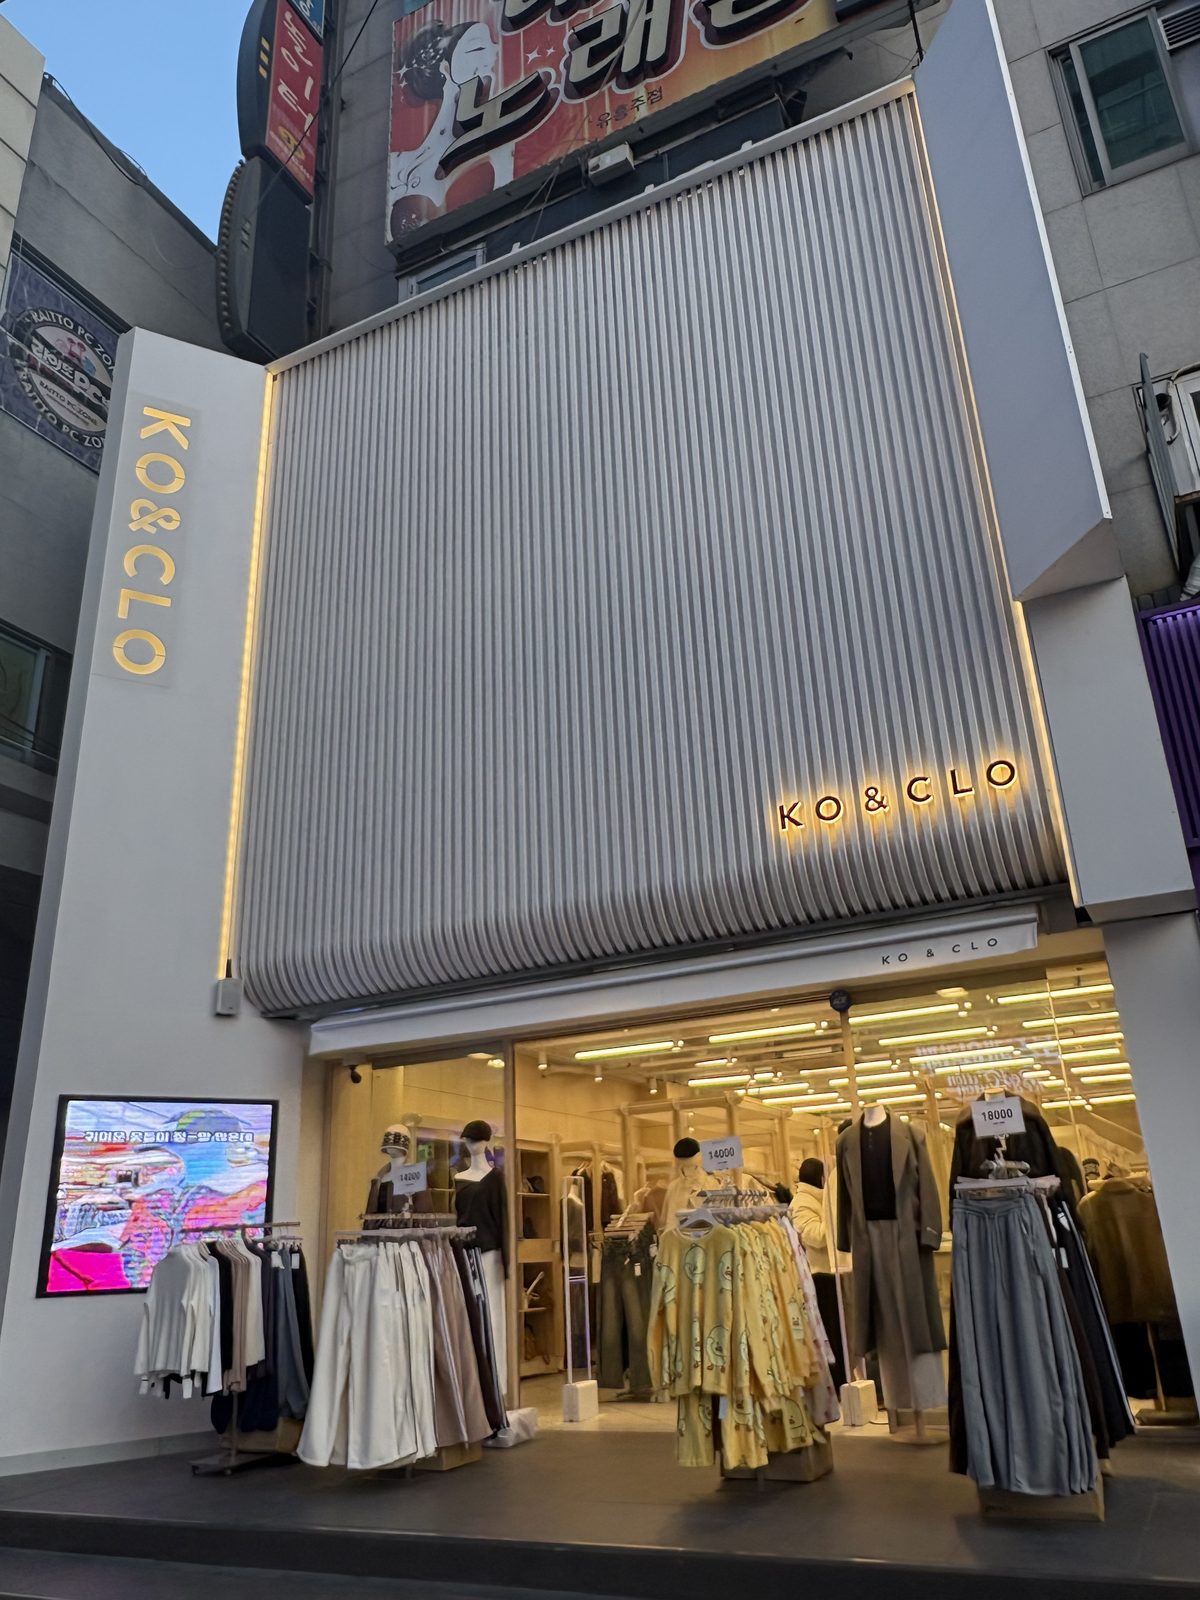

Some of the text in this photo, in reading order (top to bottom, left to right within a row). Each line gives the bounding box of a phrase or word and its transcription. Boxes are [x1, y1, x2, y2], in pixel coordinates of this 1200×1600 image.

[435, 0, 818, 180] 노래
[31, 310, 115, 370] RAITTO PC ZO
[62, 424, 80, 442] PC
[112, 406, 192, 675] KO&CLO
[981, 1108, 1013, 1121] 18000
[708, 1147, 735, 1160] 14000
